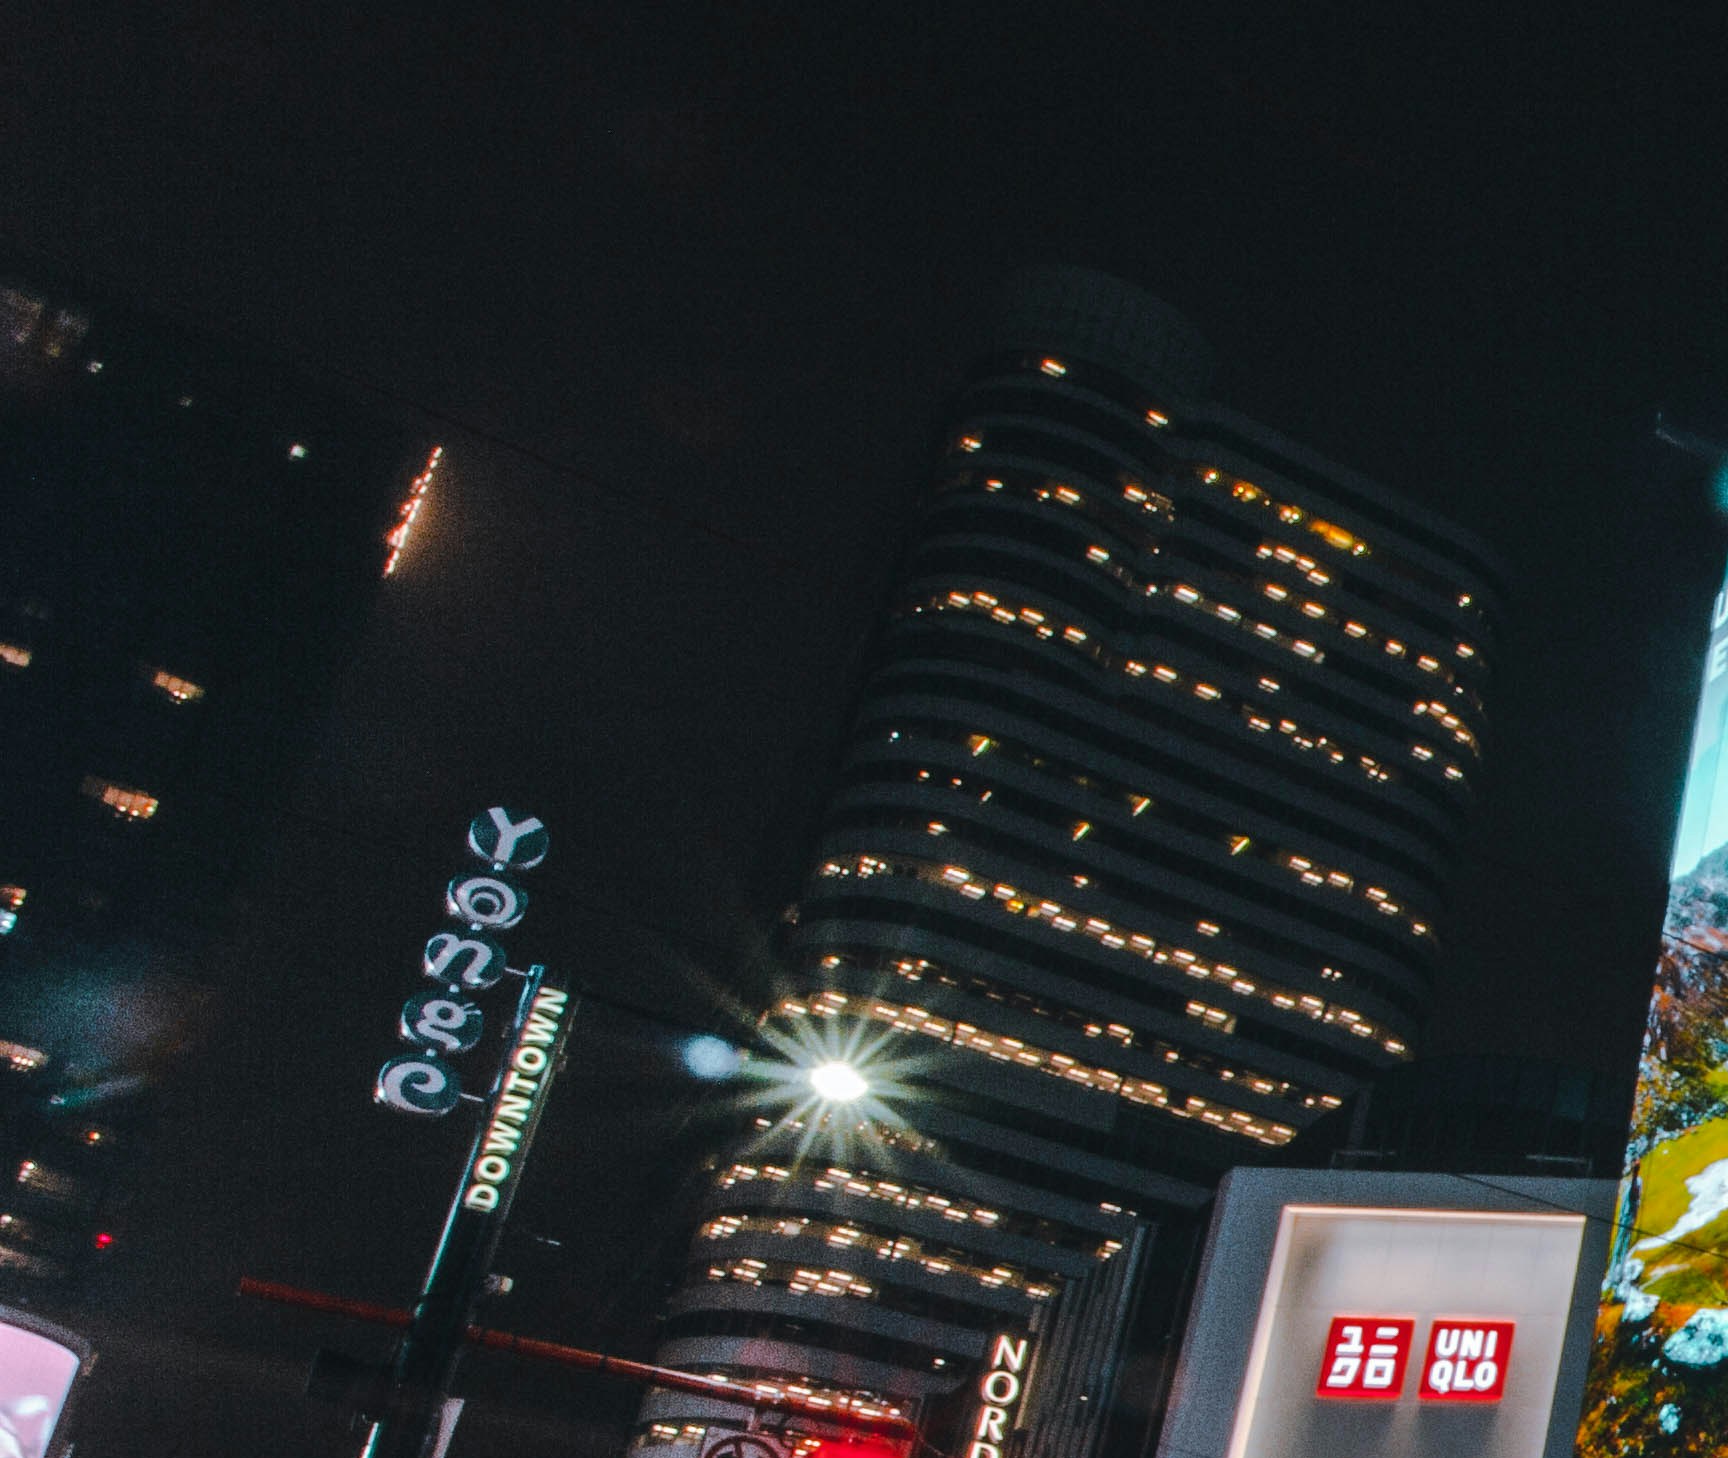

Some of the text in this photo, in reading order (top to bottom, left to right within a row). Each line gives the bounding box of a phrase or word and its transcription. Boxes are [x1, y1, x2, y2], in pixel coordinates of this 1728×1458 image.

[465, 985, 569, 1212] DOWNTOWN
[1435, 1328, 1499, 1360] UNI
[1429, 1360, 1498, 1394] QLO
